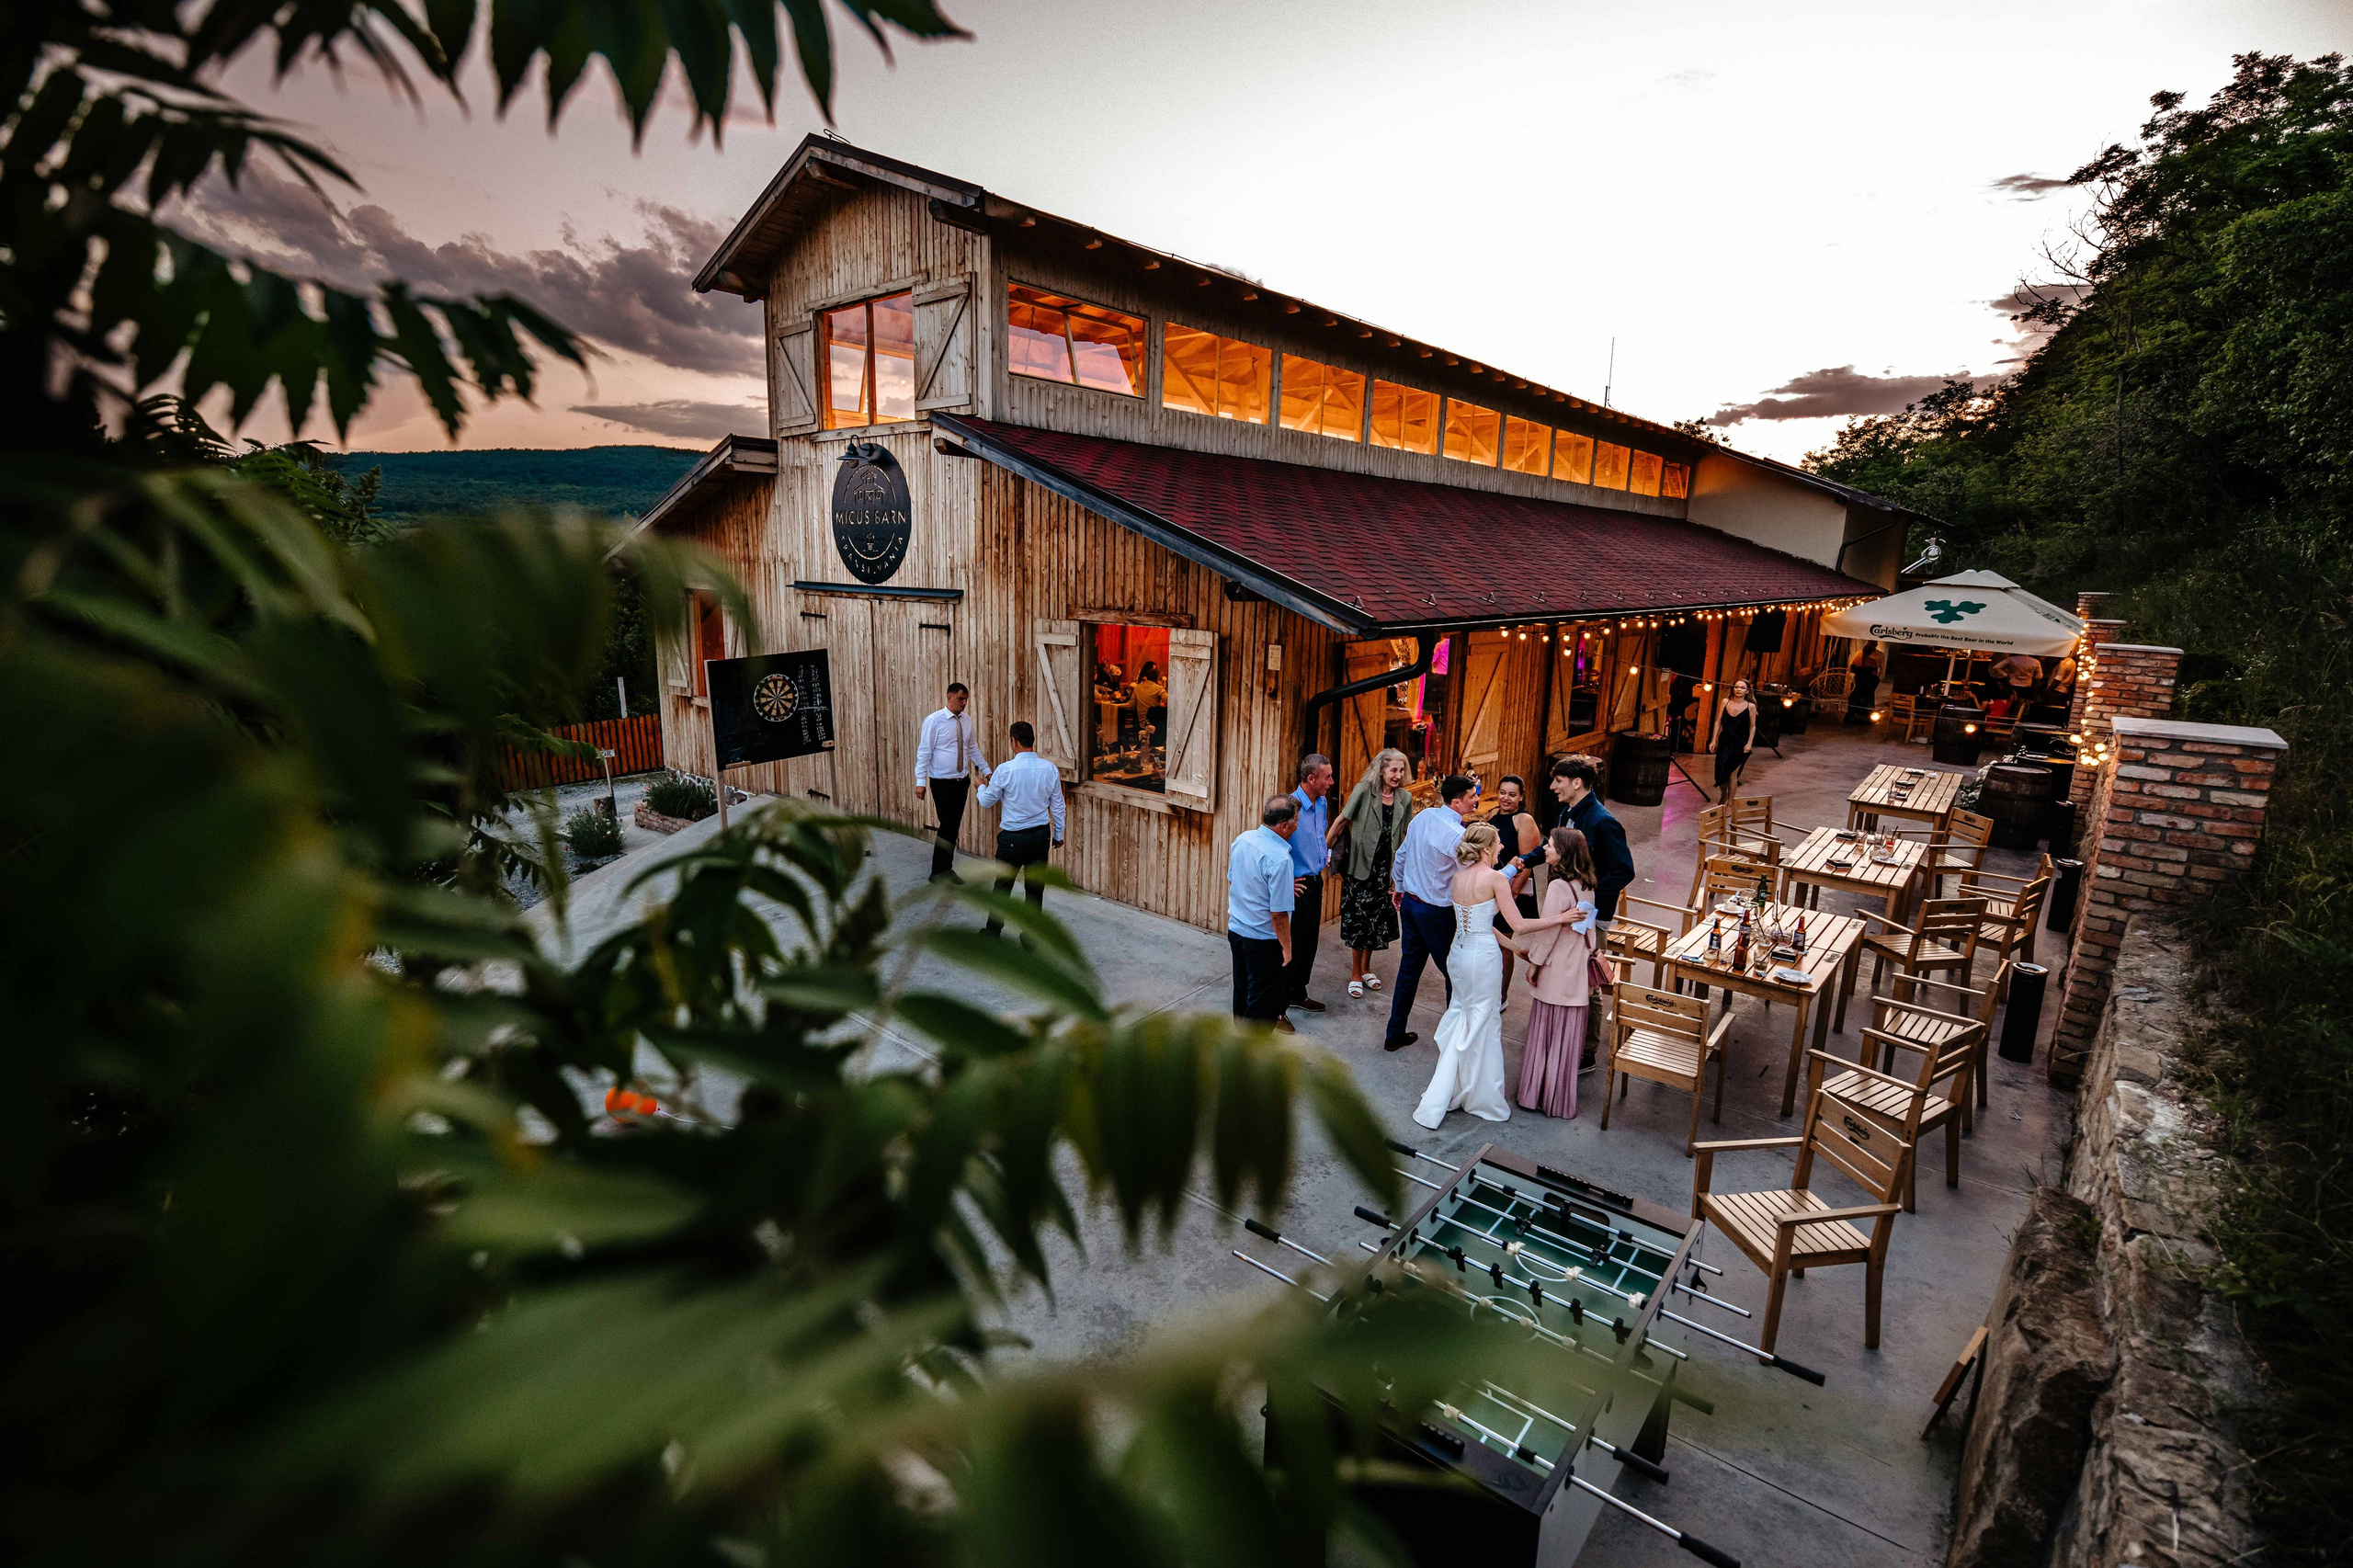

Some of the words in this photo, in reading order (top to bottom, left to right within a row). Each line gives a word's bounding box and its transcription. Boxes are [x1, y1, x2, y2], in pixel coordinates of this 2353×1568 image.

[835, 509, 870, 525] MICUS
[874, 509, 906, 525] BARN
[1870, 624, 1913, 641] Carlsberg
